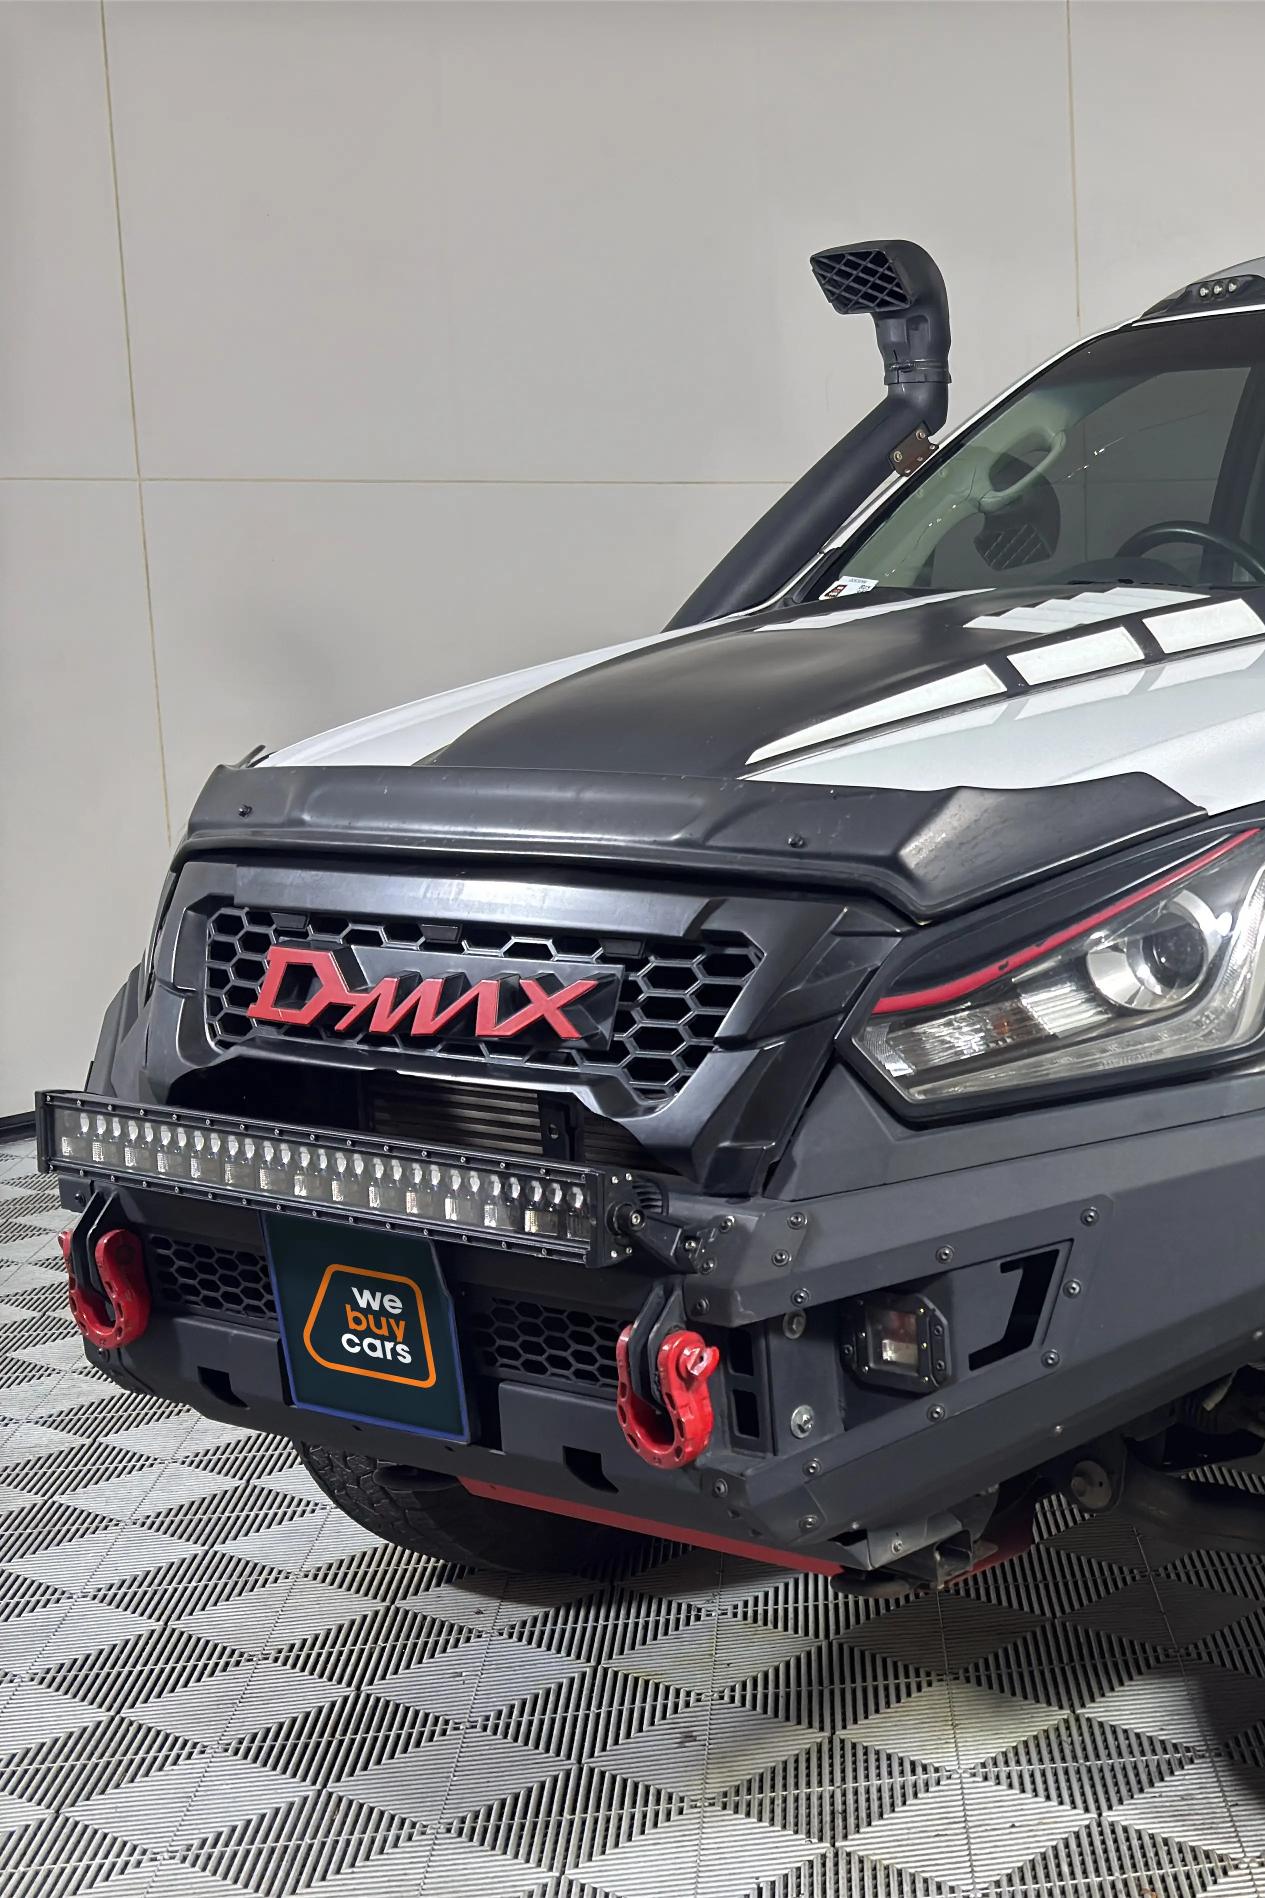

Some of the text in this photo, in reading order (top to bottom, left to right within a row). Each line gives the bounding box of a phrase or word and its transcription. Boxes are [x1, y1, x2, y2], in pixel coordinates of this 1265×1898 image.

[351, 1286, 404, 1315] we
[345, 1303, 406, 1343] buy
[341, 1333, 412, 1364] cars
